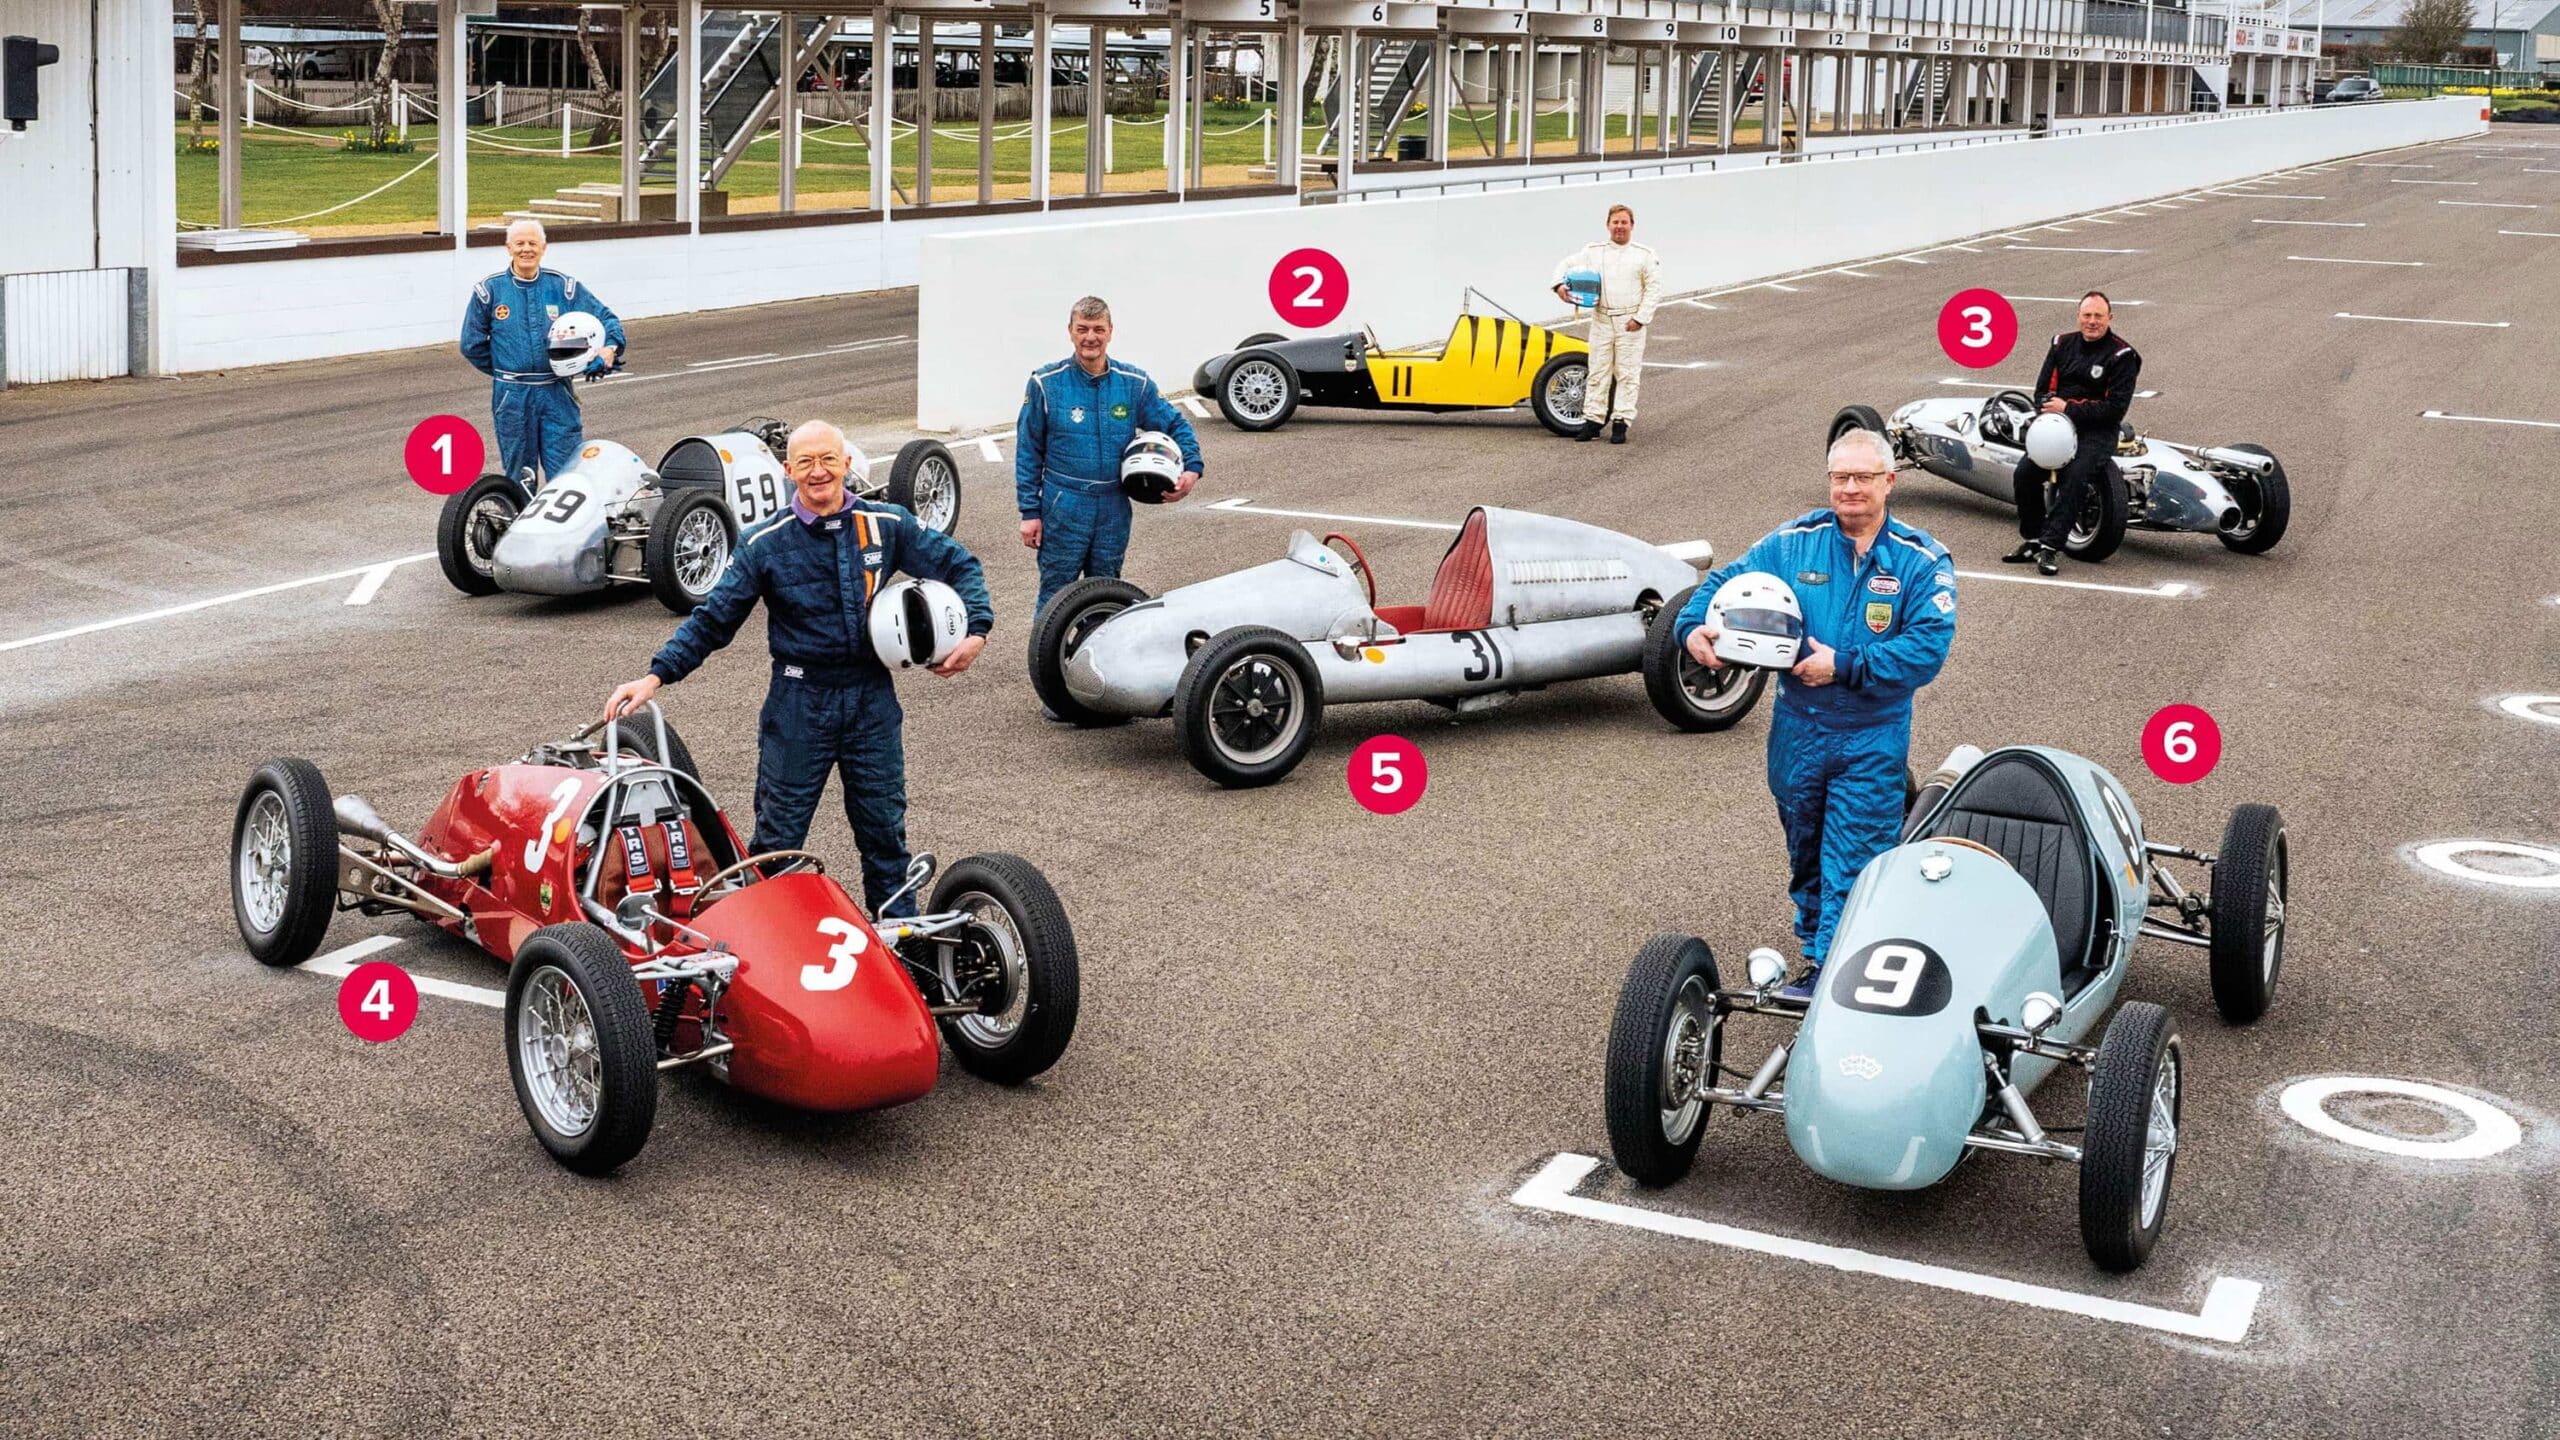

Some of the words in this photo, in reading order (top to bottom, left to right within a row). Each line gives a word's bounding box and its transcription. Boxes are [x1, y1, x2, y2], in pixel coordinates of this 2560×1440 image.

[1260, 0, 1270, 16] 5
[1372, 5, 1383, 22] 6
[1513, 13, 1524, 29] 7
[1593, 19, 1603, 33] 8
[1666, 23, 1675, 37] 9
[1721, 27, 1737, 40] 10
[1780, 30, 1793, 43] 11
[1829, 33, 1843, 46] 12
[1896, 37, 1910, 49] 14
[1937, 40, 1951, 51] 15
[1973, 42, 1986, 53] 16
[2007, 44, 2019, 54] 17
[2038, 46, 2051, 56] 18
[2068, 48, 2080, 58] 19
[2115, 51, 2128, 61] 20
[2141, 53, 2151, 62] 21
[2161, 53, 2172, 63] 22
[2201, 56, 2212, 65] 24
[2219, 56, 2230, 66] 25
[736, 473, 778, 524] 59
[518, 488, 587, 524] 59
[863, 552, 883, 566] OMP
[1451, 630, 1503, 681] 31
[784, 665, 804, 679] OMP
[523, 777, 582, 874] 3
[2103, 785, 2140, 865] 9
[622, 826, 645, 865] TRS
[664, 820, 687, 858] TRS
[799, 916, 869, 991] 3
[1854, 945, 1927, 1008] 9
